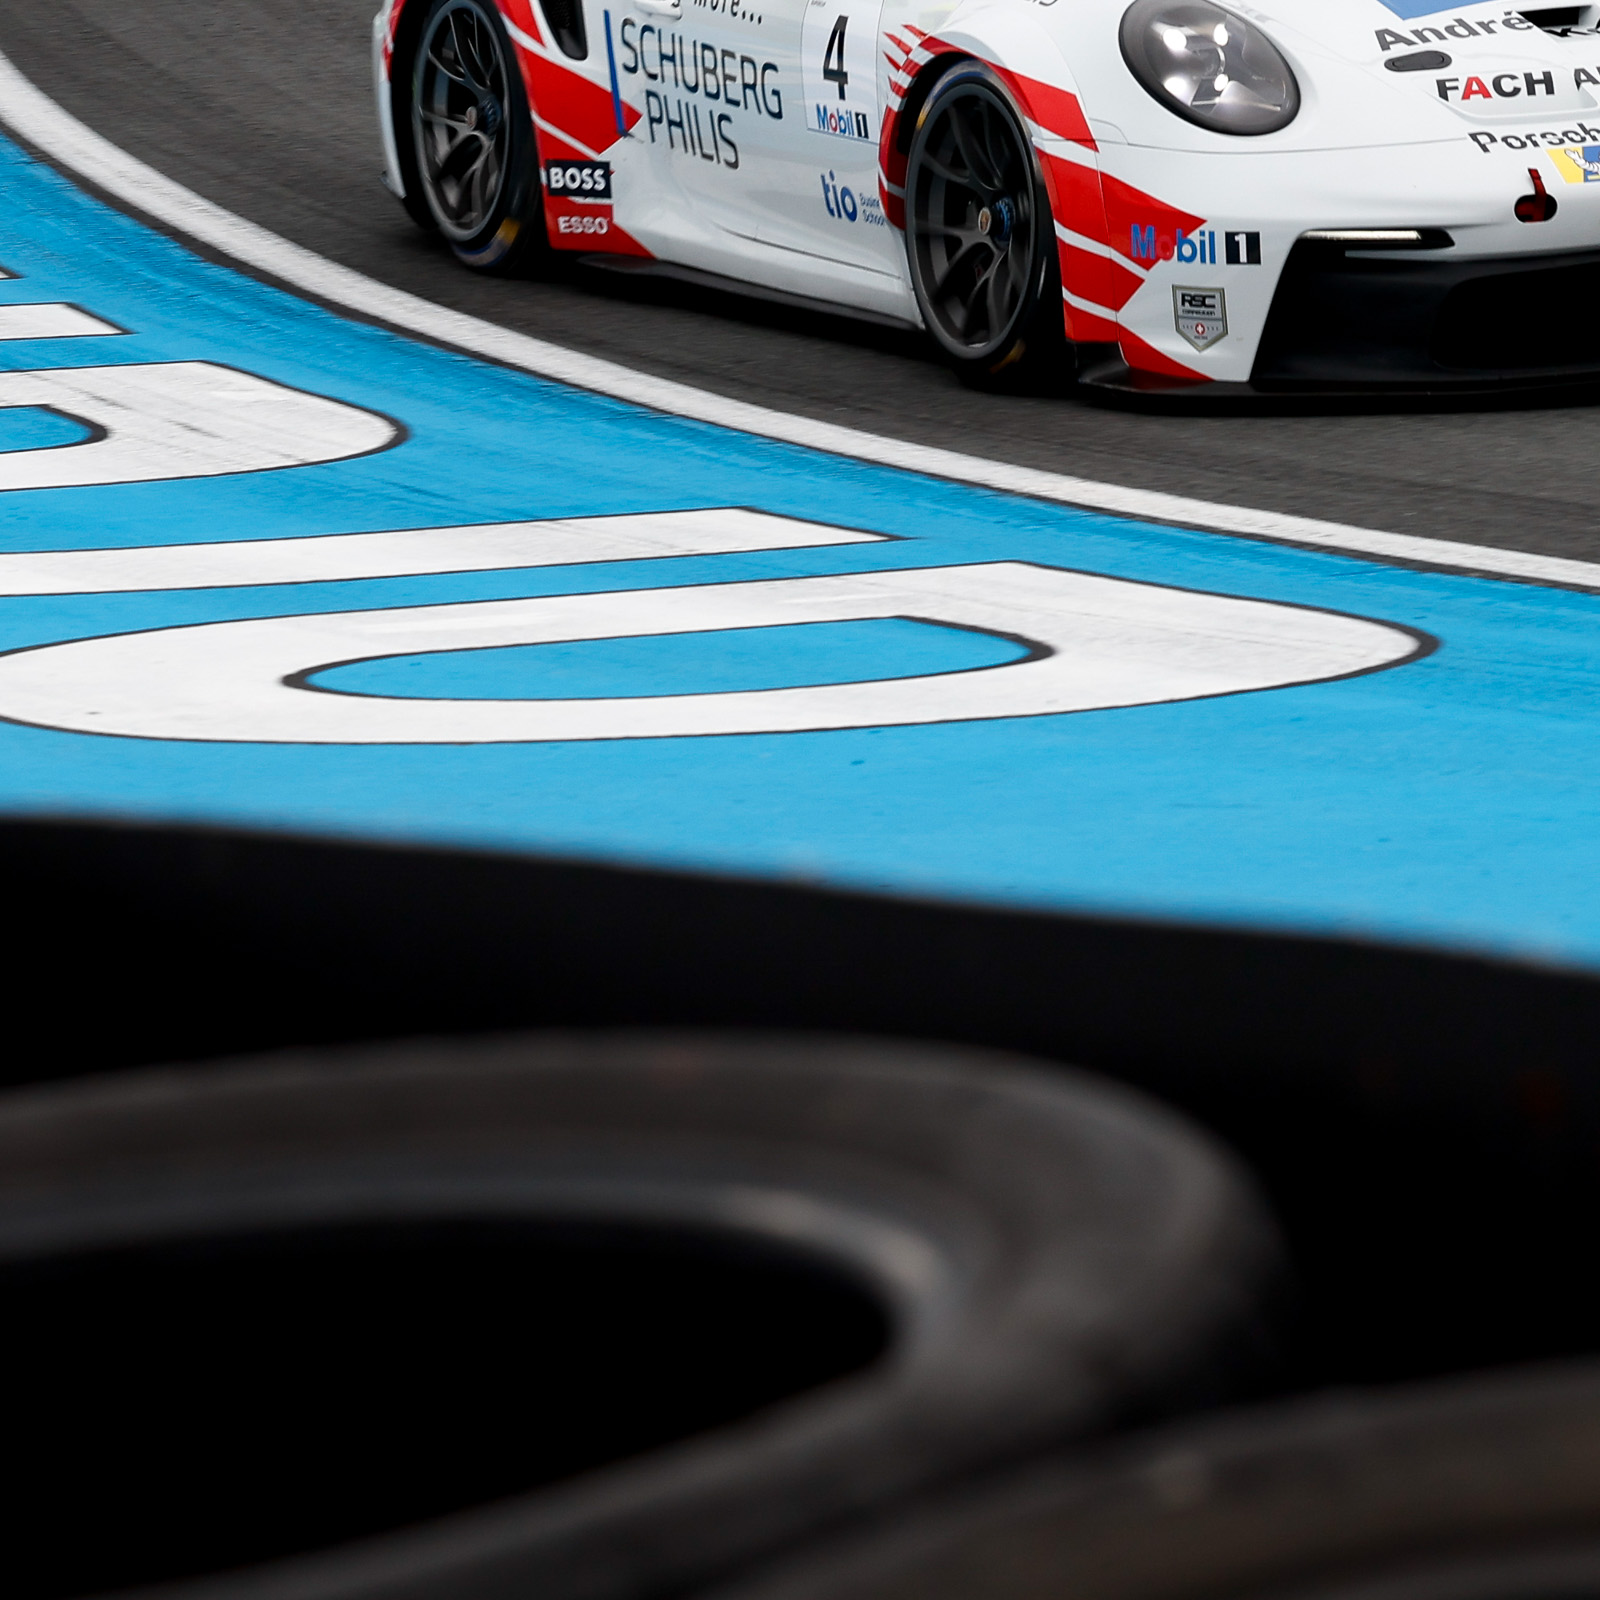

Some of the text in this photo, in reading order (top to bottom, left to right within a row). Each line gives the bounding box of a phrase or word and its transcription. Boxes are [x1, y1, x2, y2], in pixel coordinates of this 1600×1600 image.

[621, 17, 784, 120] SCHUBERG
[823, 14, 850, 101] 4
[1435, 70, 1556, 102] FACH
[645, 88, 740, 170] PHILIS
[816, 103, 868, 139] Mobil 1
[549, 166, 607, 191] BOSS
[820, 168, 858, 223] tio
[1131, 223, 1217, 265] Mobil
[1181, 292, 1216, 309] RSC
